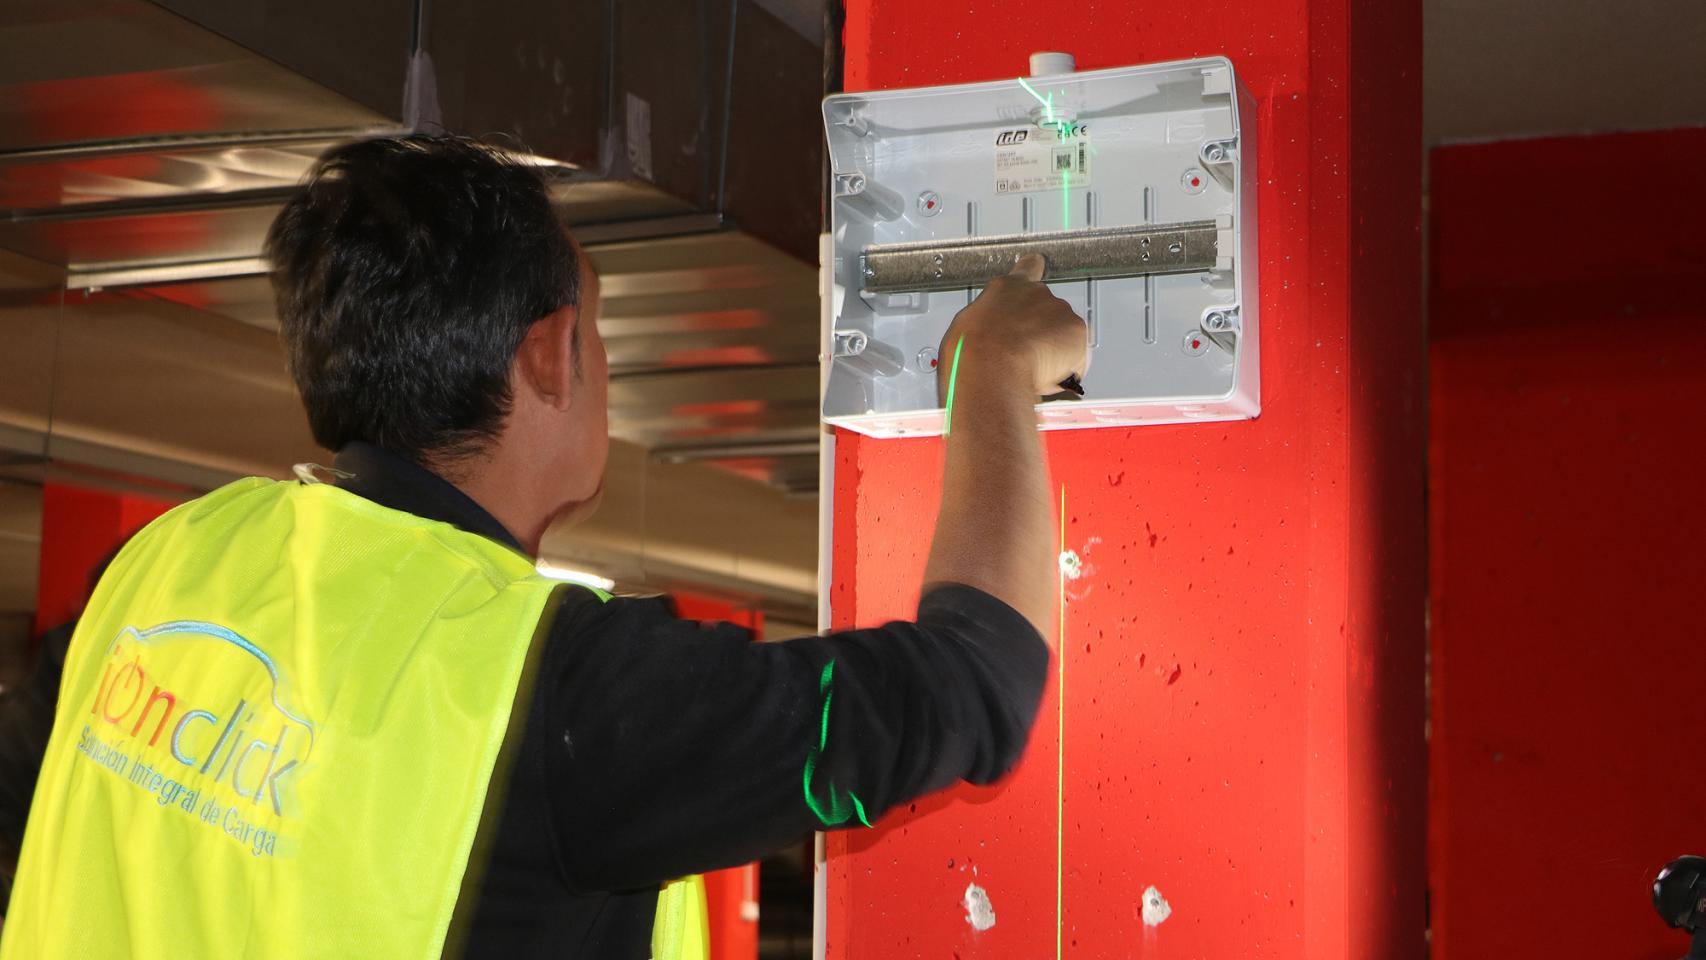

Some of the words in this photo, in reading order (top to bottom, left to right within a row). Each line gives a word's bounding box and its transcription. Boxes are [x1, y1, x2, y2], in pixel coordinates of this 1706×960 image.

[128, 754, 200, 815] Integral
[199, 796, 220, 826] de
[223, 806, 277, 857] Carga
